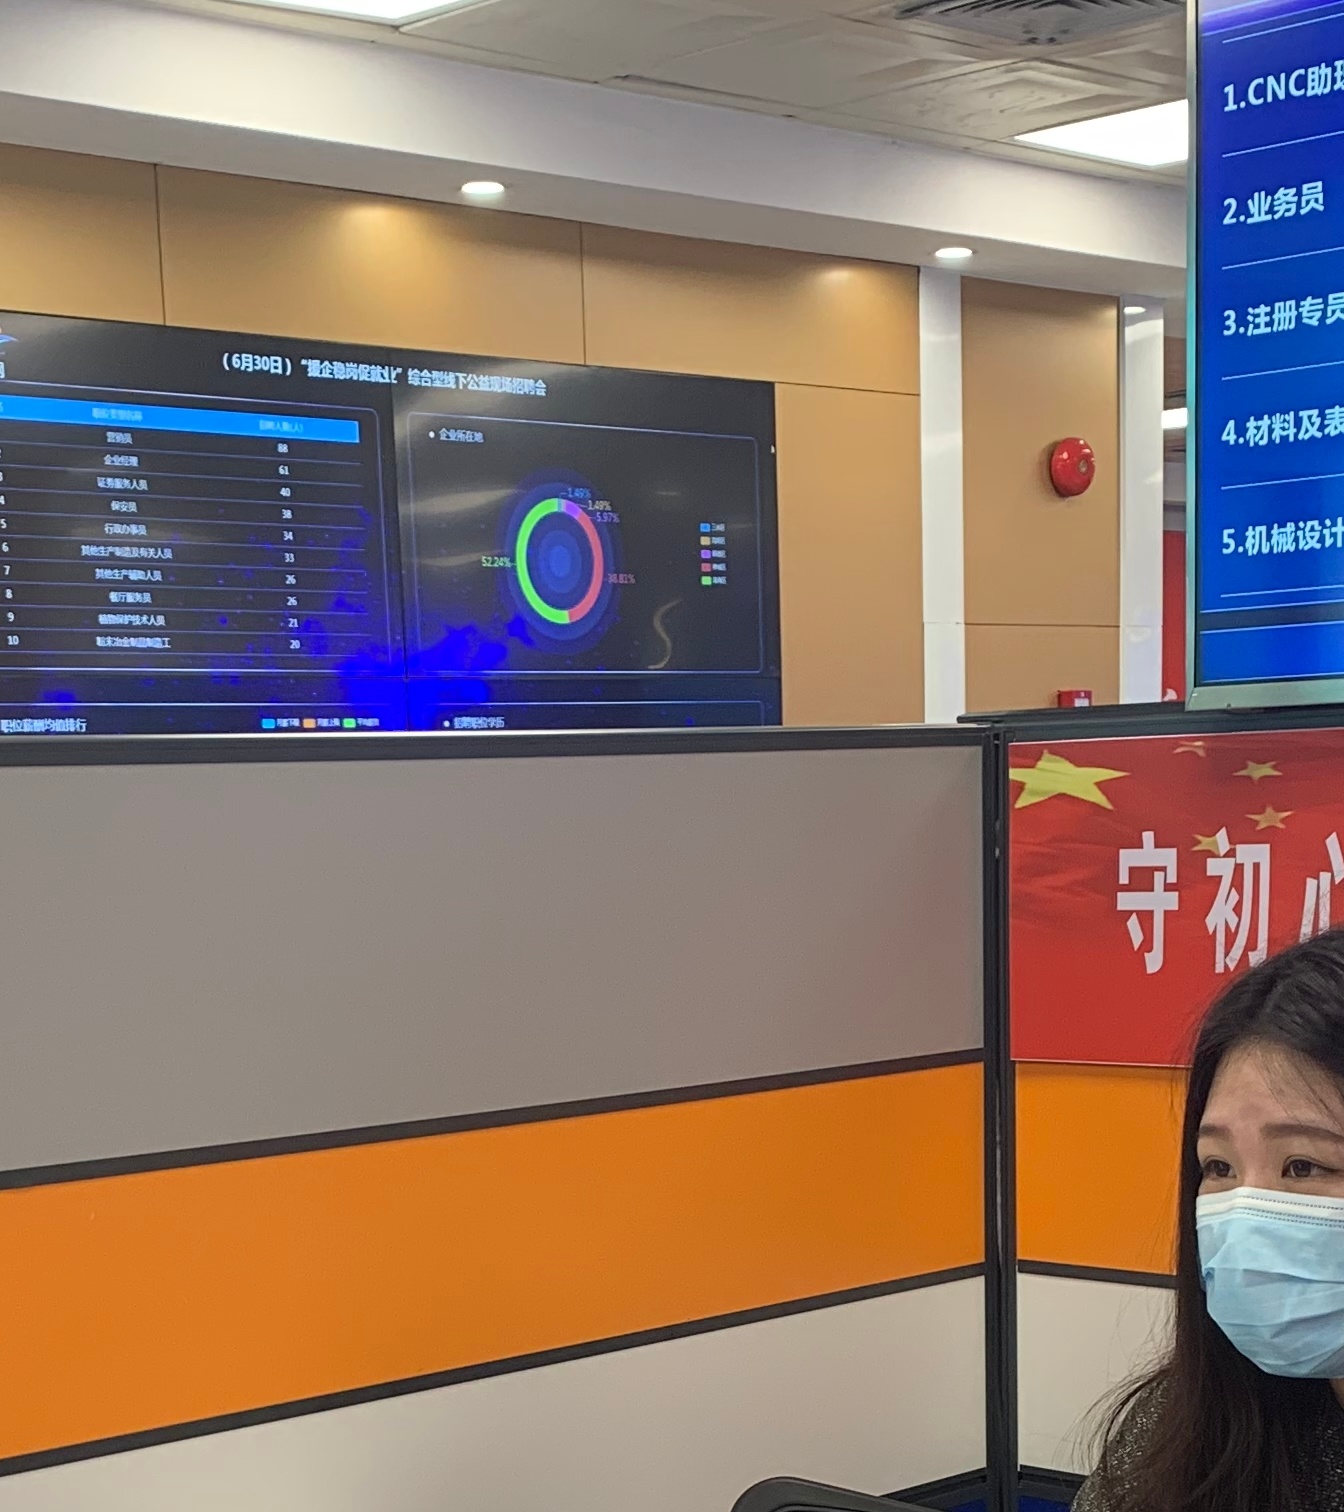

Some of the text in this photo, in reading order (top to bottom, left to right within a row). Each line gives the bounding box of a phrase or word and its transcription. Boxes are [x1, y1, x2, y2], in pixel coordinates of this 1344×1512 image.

[1222, 181, 1325, 225] 2.业务员
[0, 519, 7, 530] 5
[1, 542, 9, 553] 6
[3, 565, 10, 576] 7
[5, 588, 13, 600] 8
[7, 612, 15, 623] 9
[7, 635, 20, 646] 10
